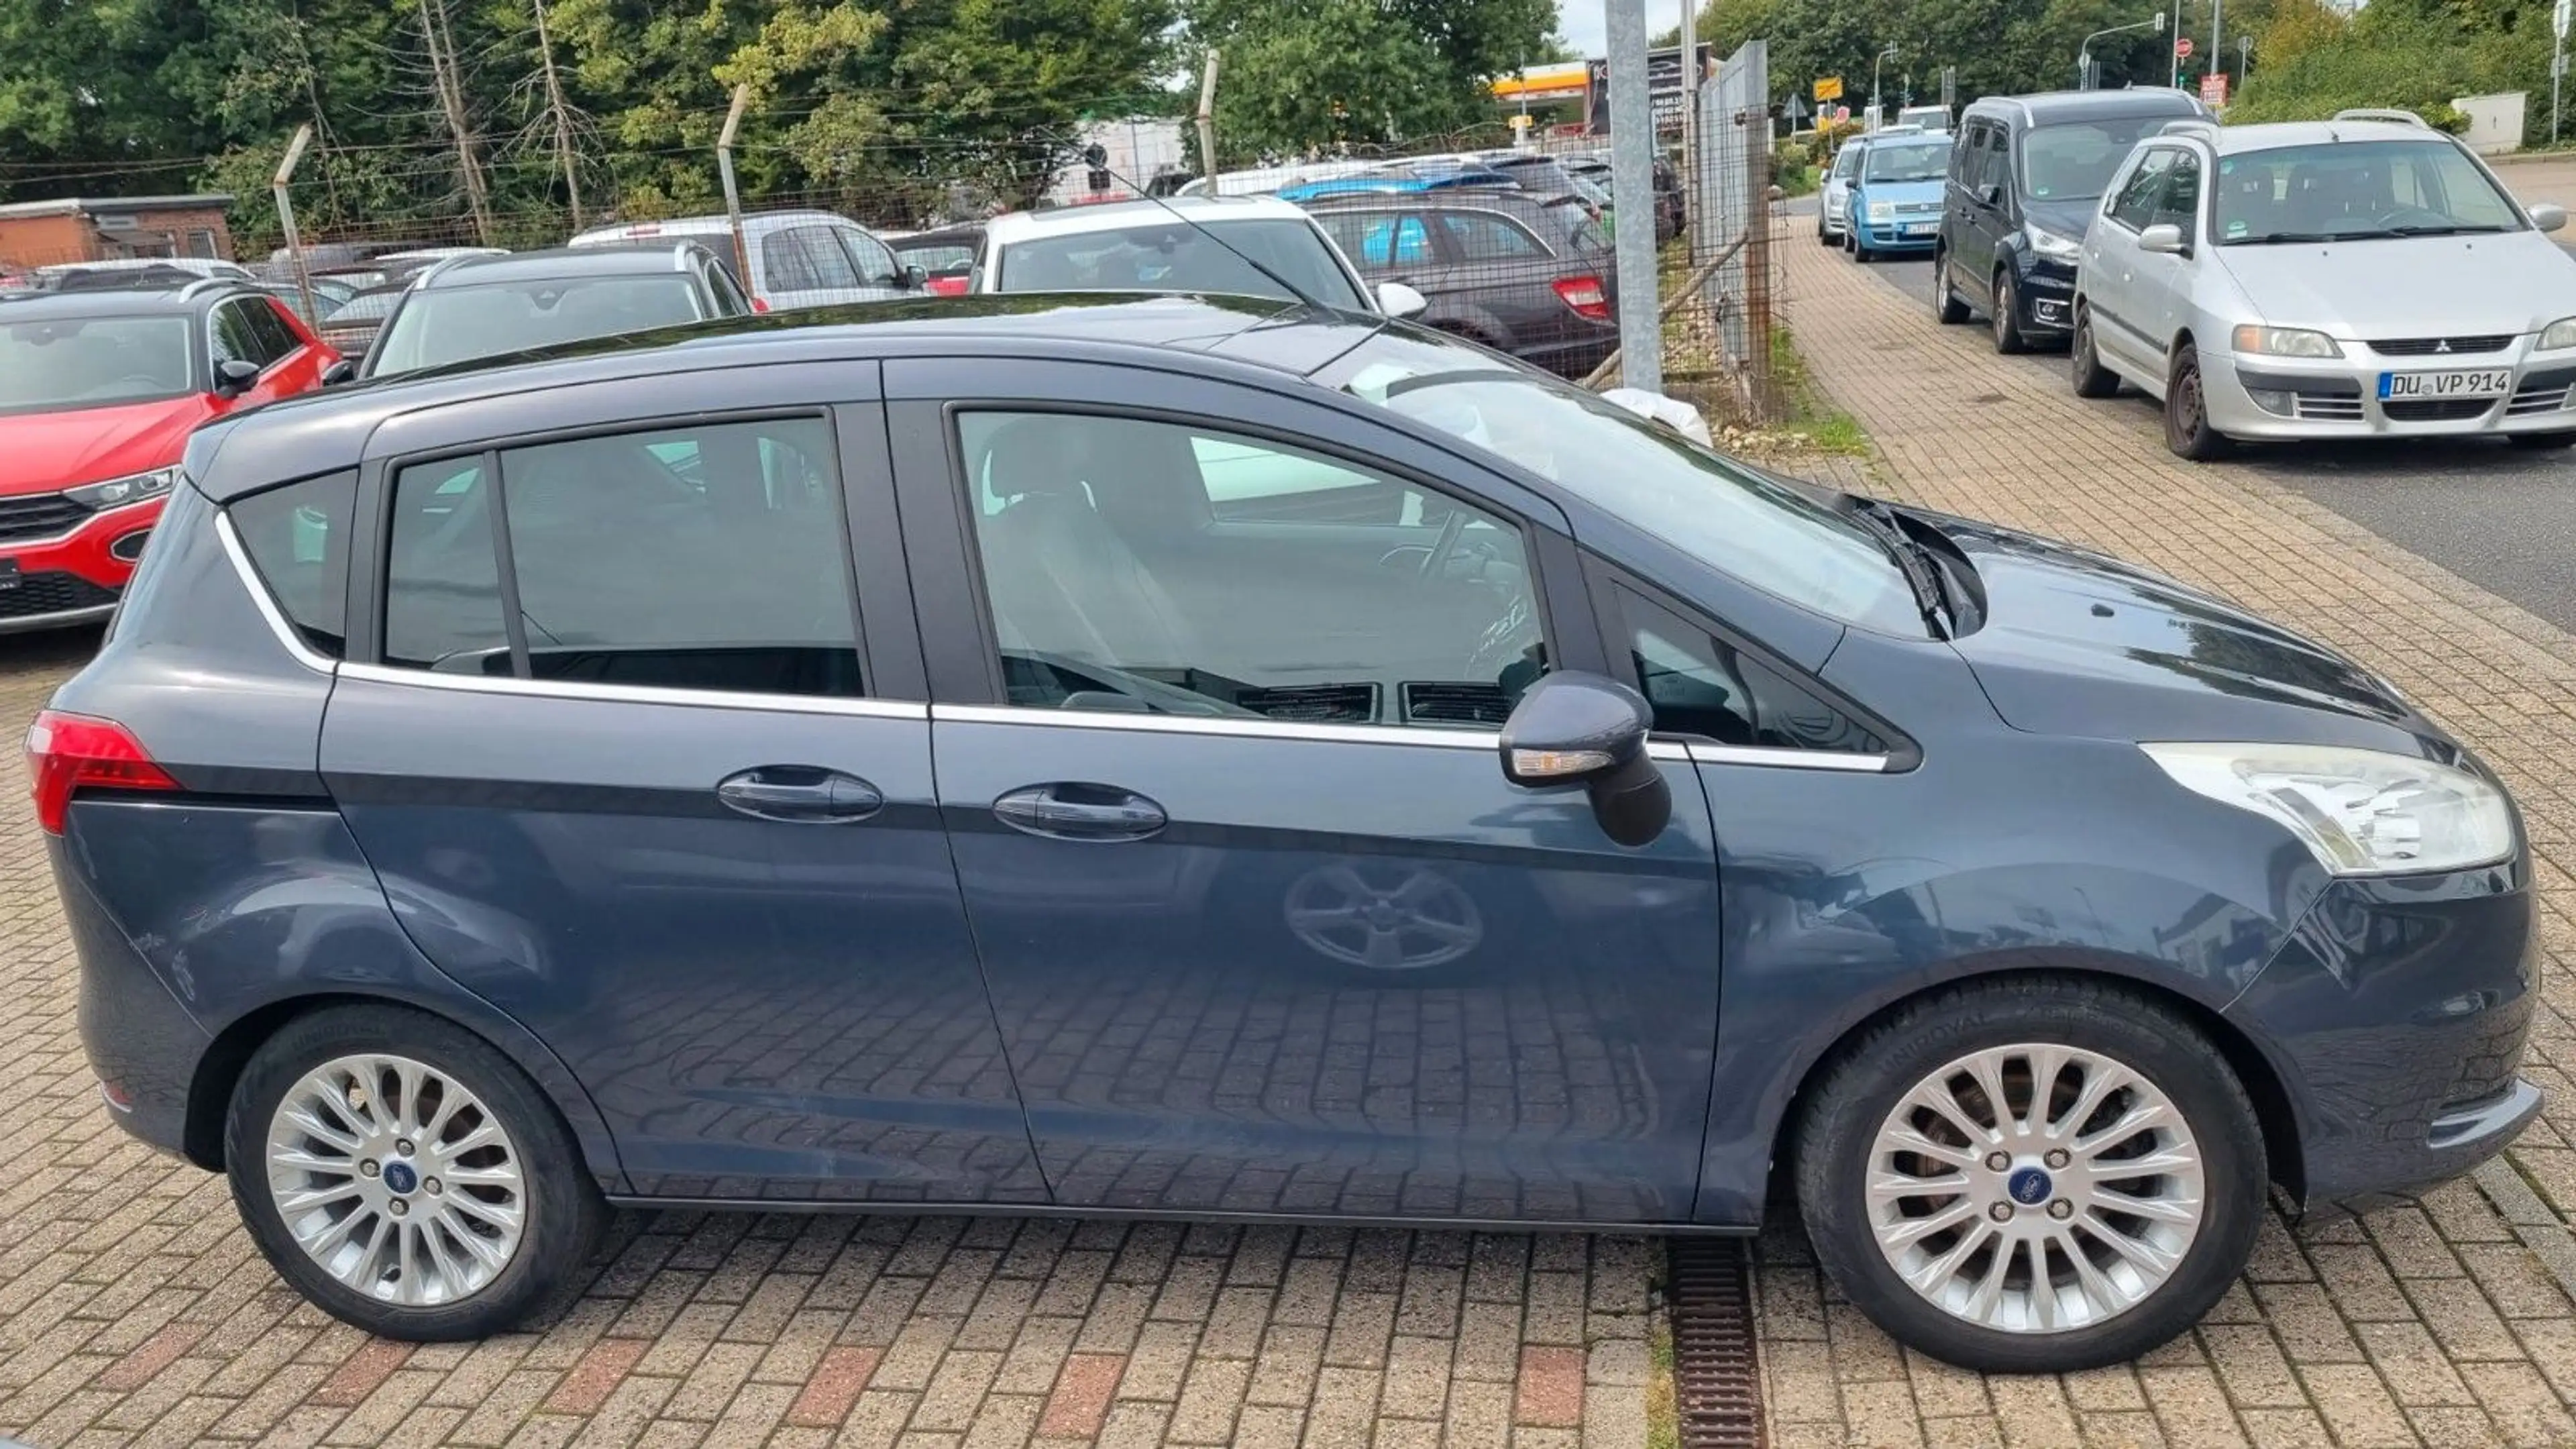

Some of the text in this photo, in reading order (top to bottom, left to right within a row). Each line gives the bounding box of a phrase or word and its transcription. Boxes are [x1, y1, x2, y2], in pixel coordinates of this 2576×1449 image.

[2392, 372, 2508, 394] DU VP 914
[1879, 1013, 1985, 1072] UNIROYAL
